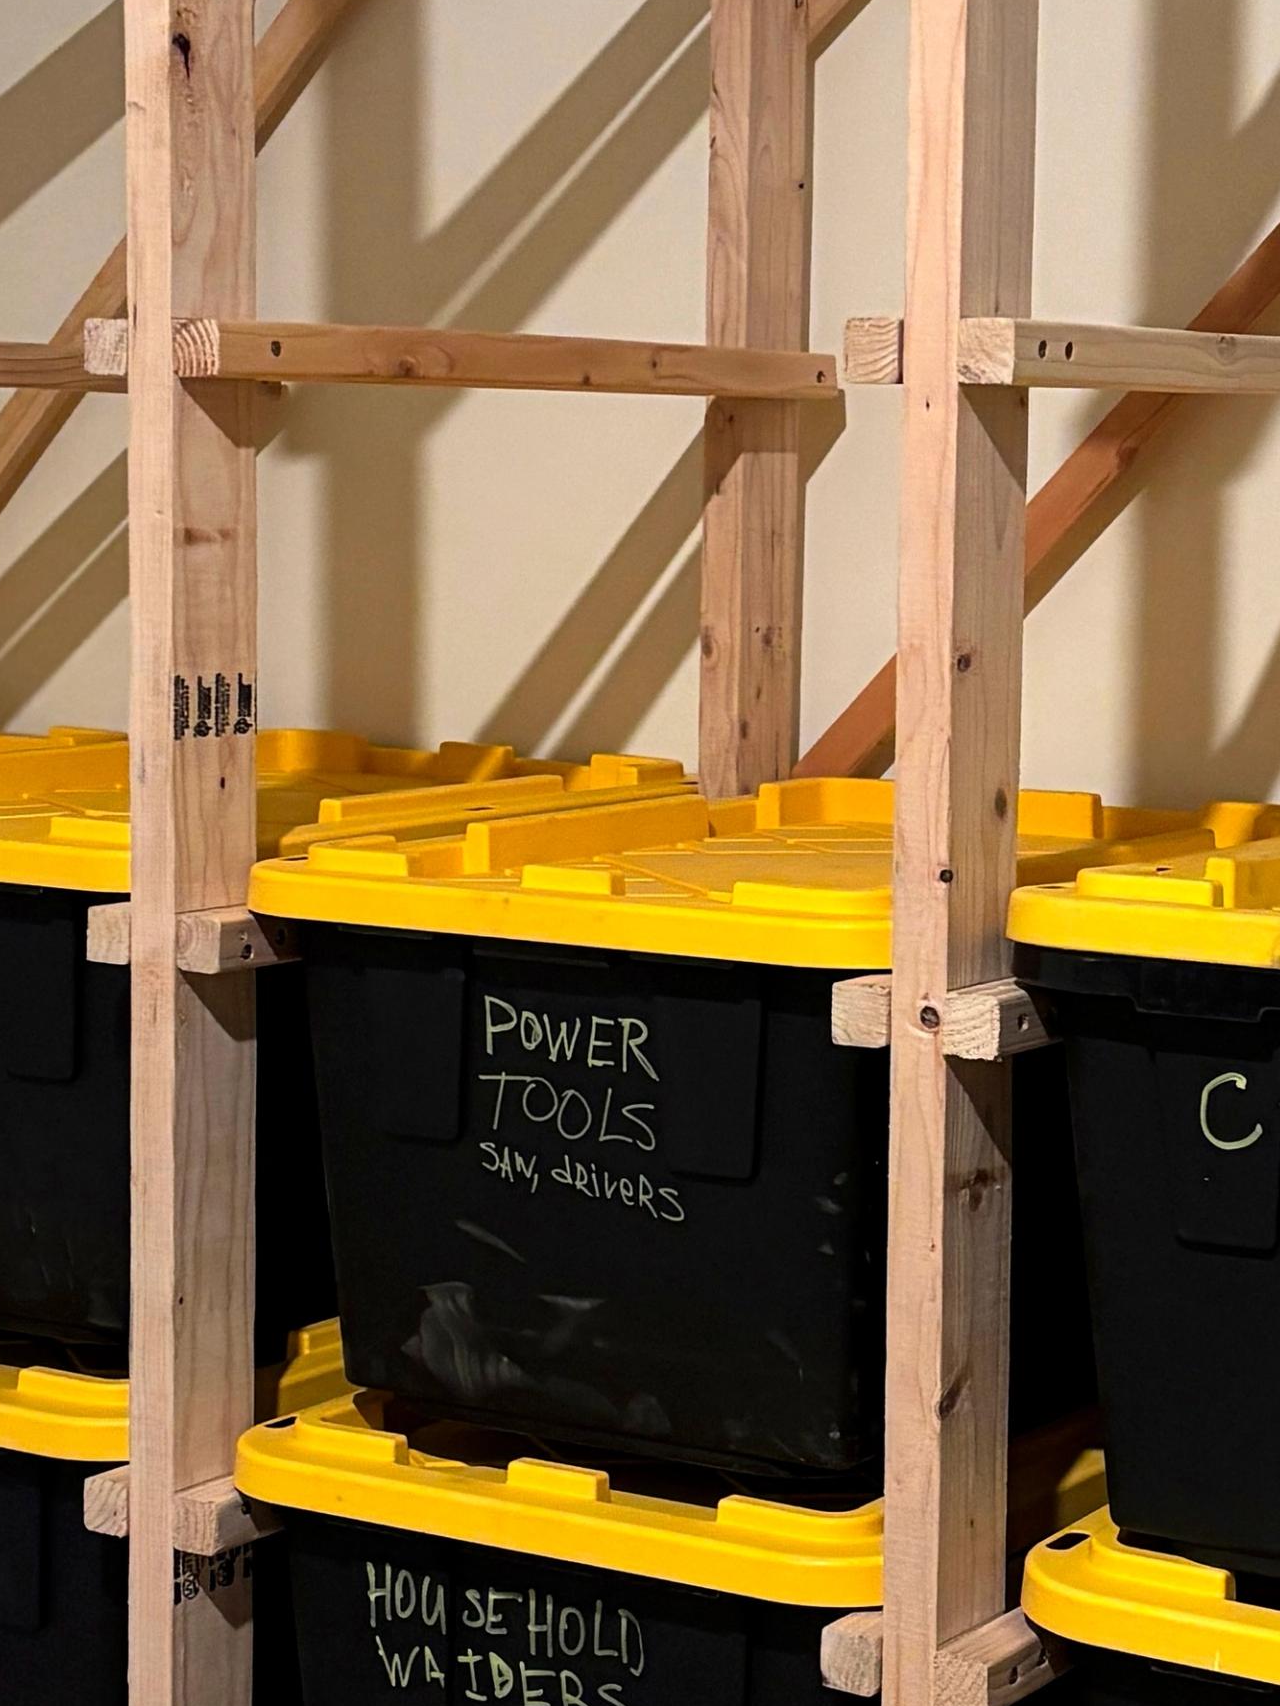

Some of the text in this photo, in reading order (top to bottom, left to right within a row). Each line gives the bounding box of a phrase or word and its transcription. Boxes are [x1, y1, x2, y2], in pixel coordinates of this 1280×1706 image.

[484, 994, 659, 1081] POWER
[478, 1071, 655, 1151] TOOLS
[366, 1561, 644, 1677] HOUSEHOLD
